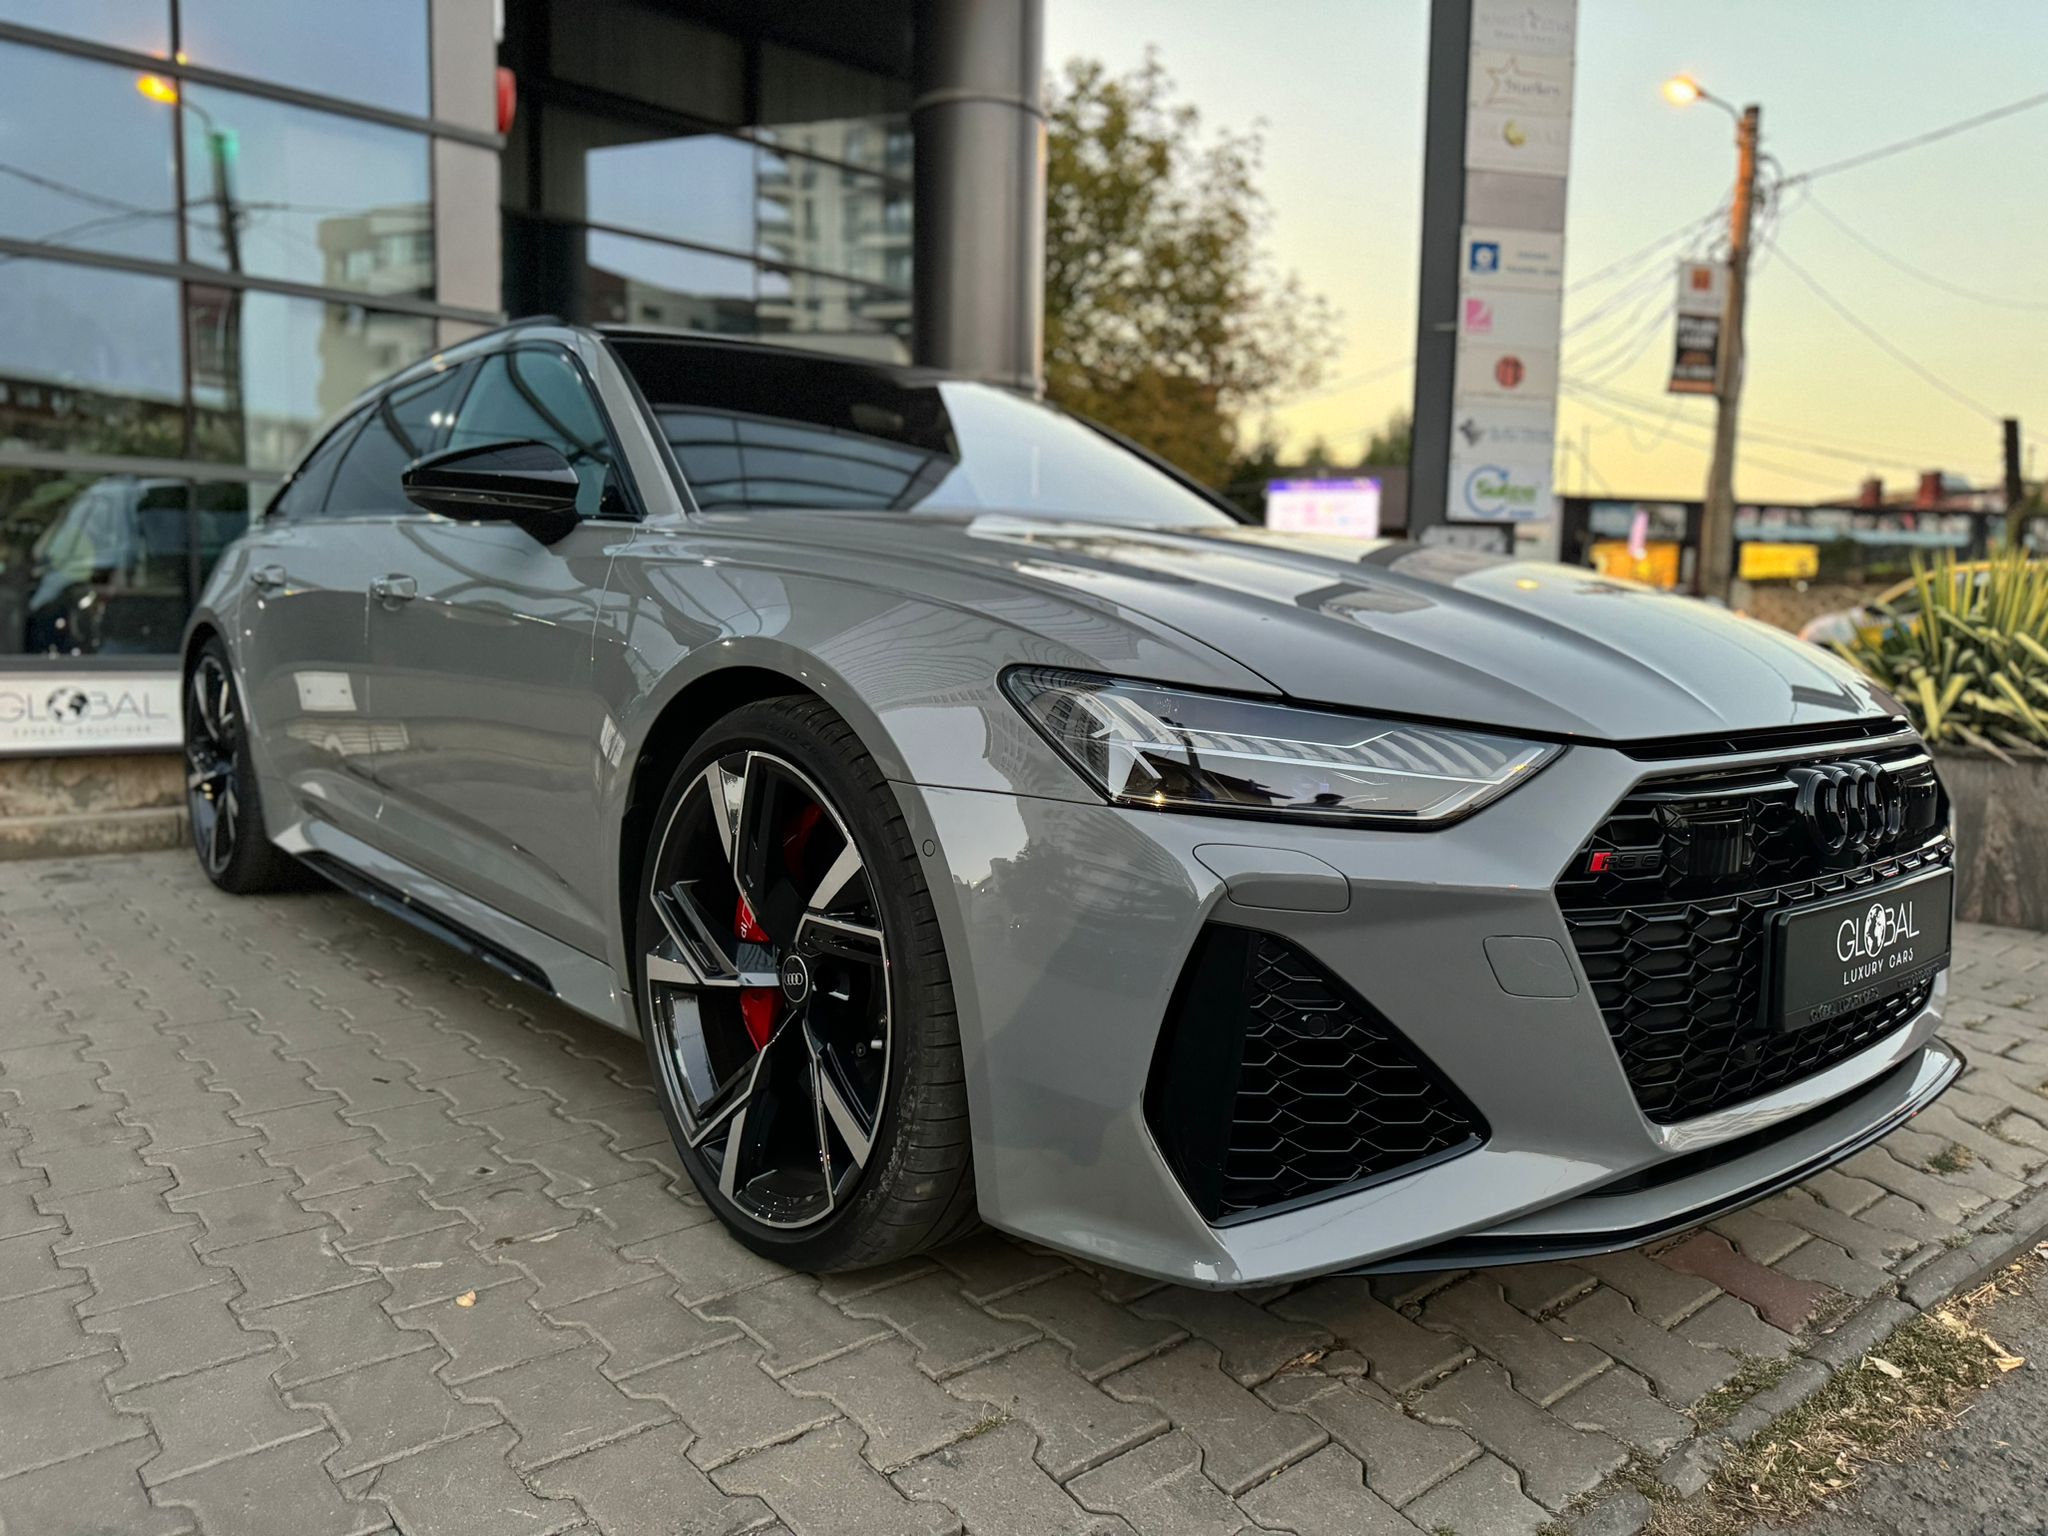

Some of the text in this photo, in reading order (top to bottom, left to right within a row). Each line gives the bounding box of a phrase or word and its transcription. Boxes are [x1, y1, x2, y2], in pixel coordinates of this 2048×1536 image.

[0, 685, 168, 726] GLOBAL
[1836, 901, 1921, 962] GLOBAL
[1843, 958, 1884, 985] LUXURY
[1889, 946, 1914, 969] CARS
